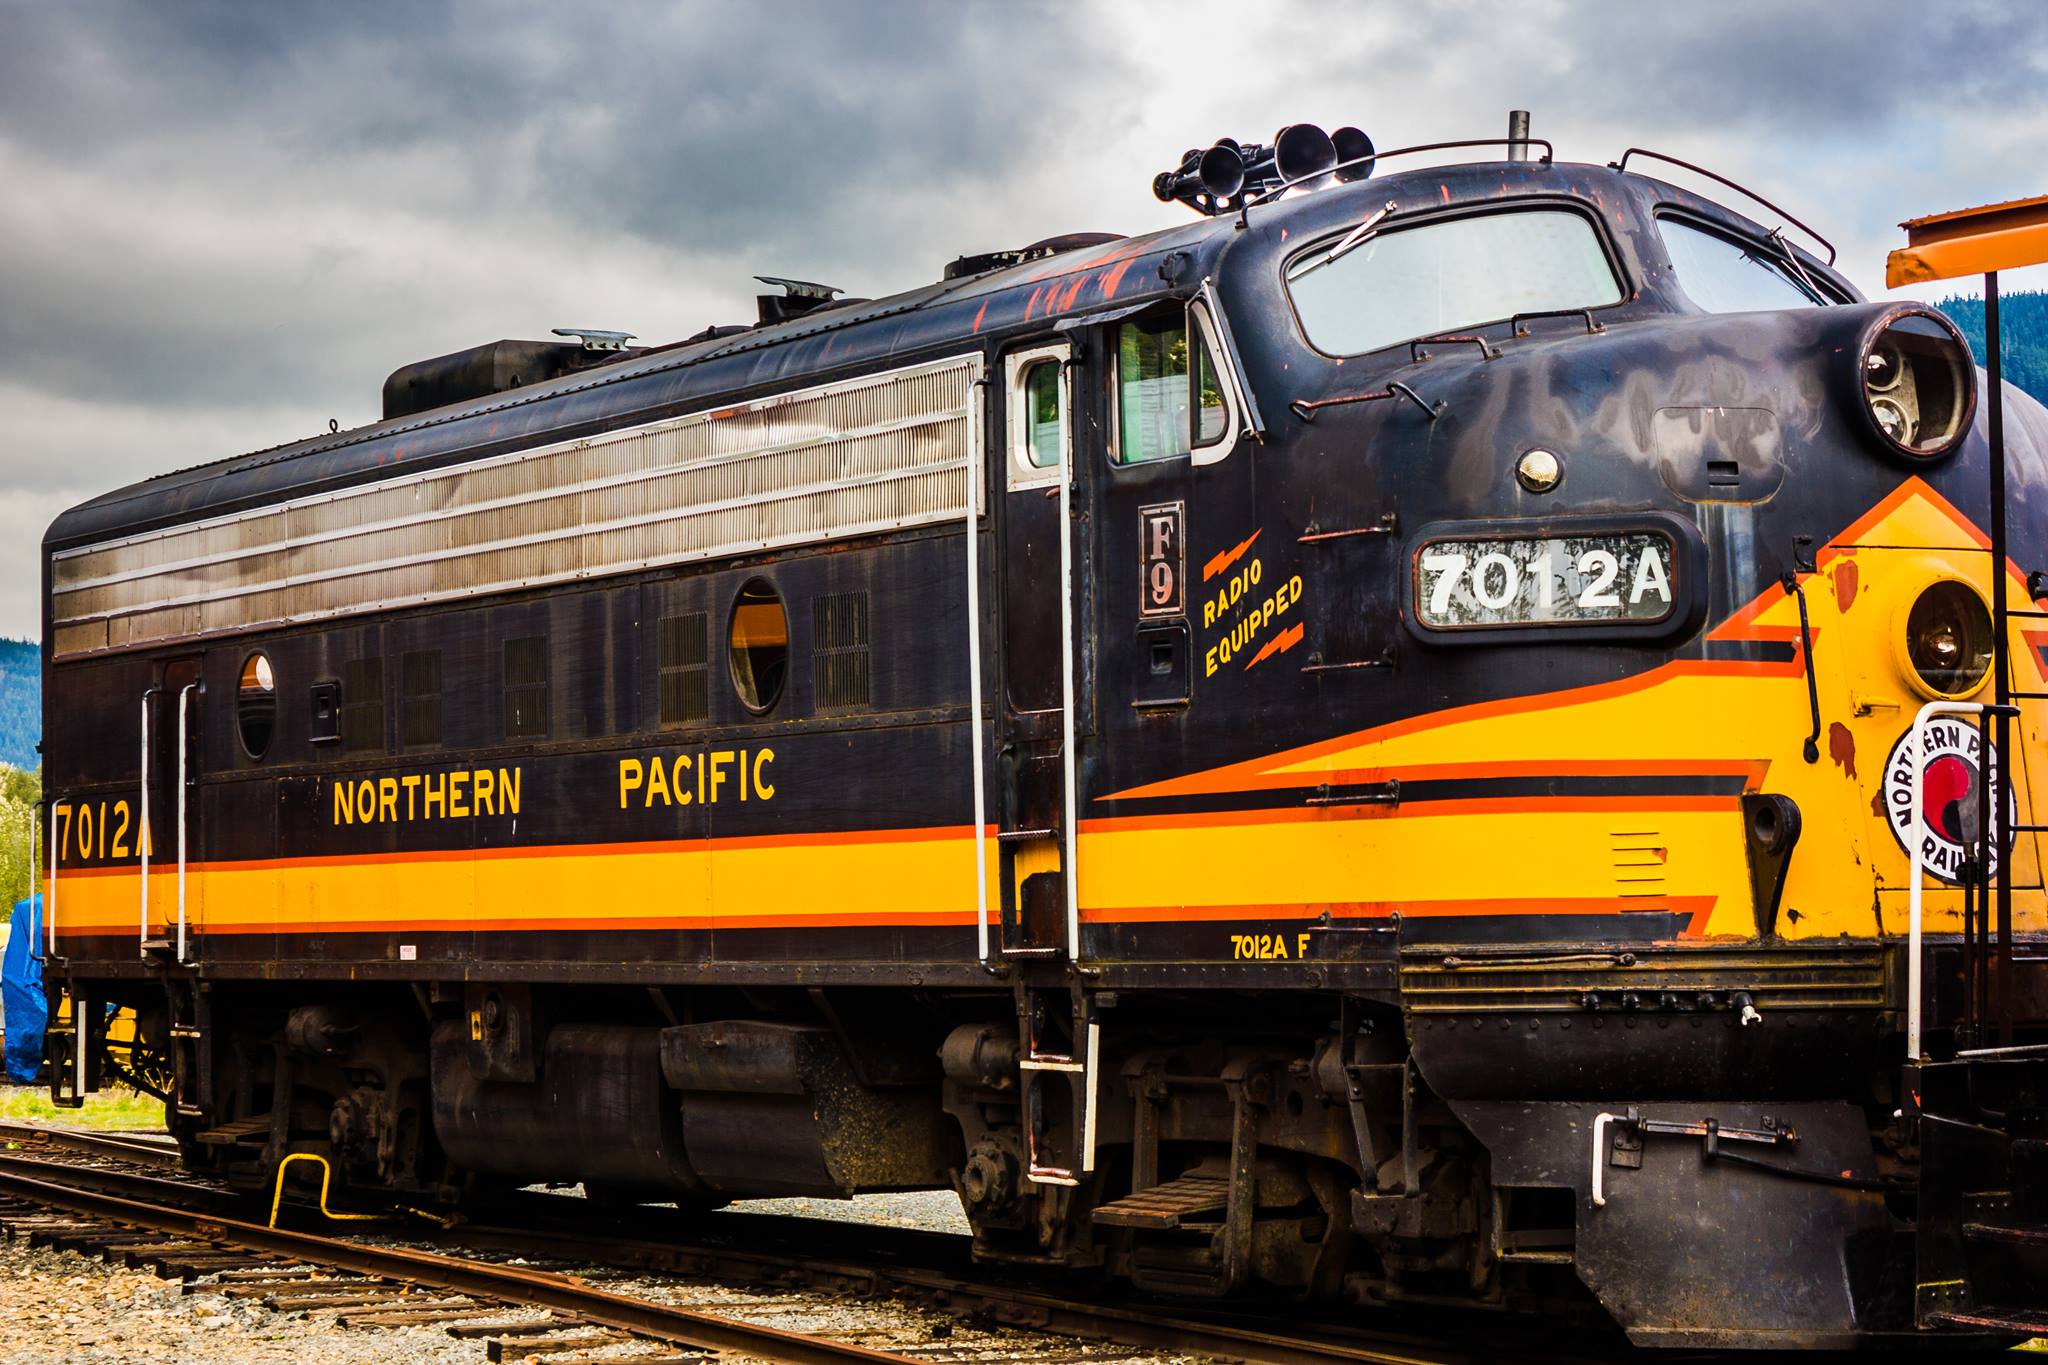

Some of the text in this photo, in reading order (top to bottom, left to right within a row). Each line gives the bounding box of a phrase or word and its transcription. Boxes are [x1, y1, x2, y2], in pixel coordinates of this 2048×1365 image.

[1204, 558, 1262, 628] RADIO
[1424, 547, 1672, 613] 7012A
[1206, 575, 1302, 677] EQUIPPED
[334, 748, 775, 825] NORTHERN PACIFIC
[1892, 726, 1960, 828] NORTERN
[1231, 933, 1311, 959] 7012A F
